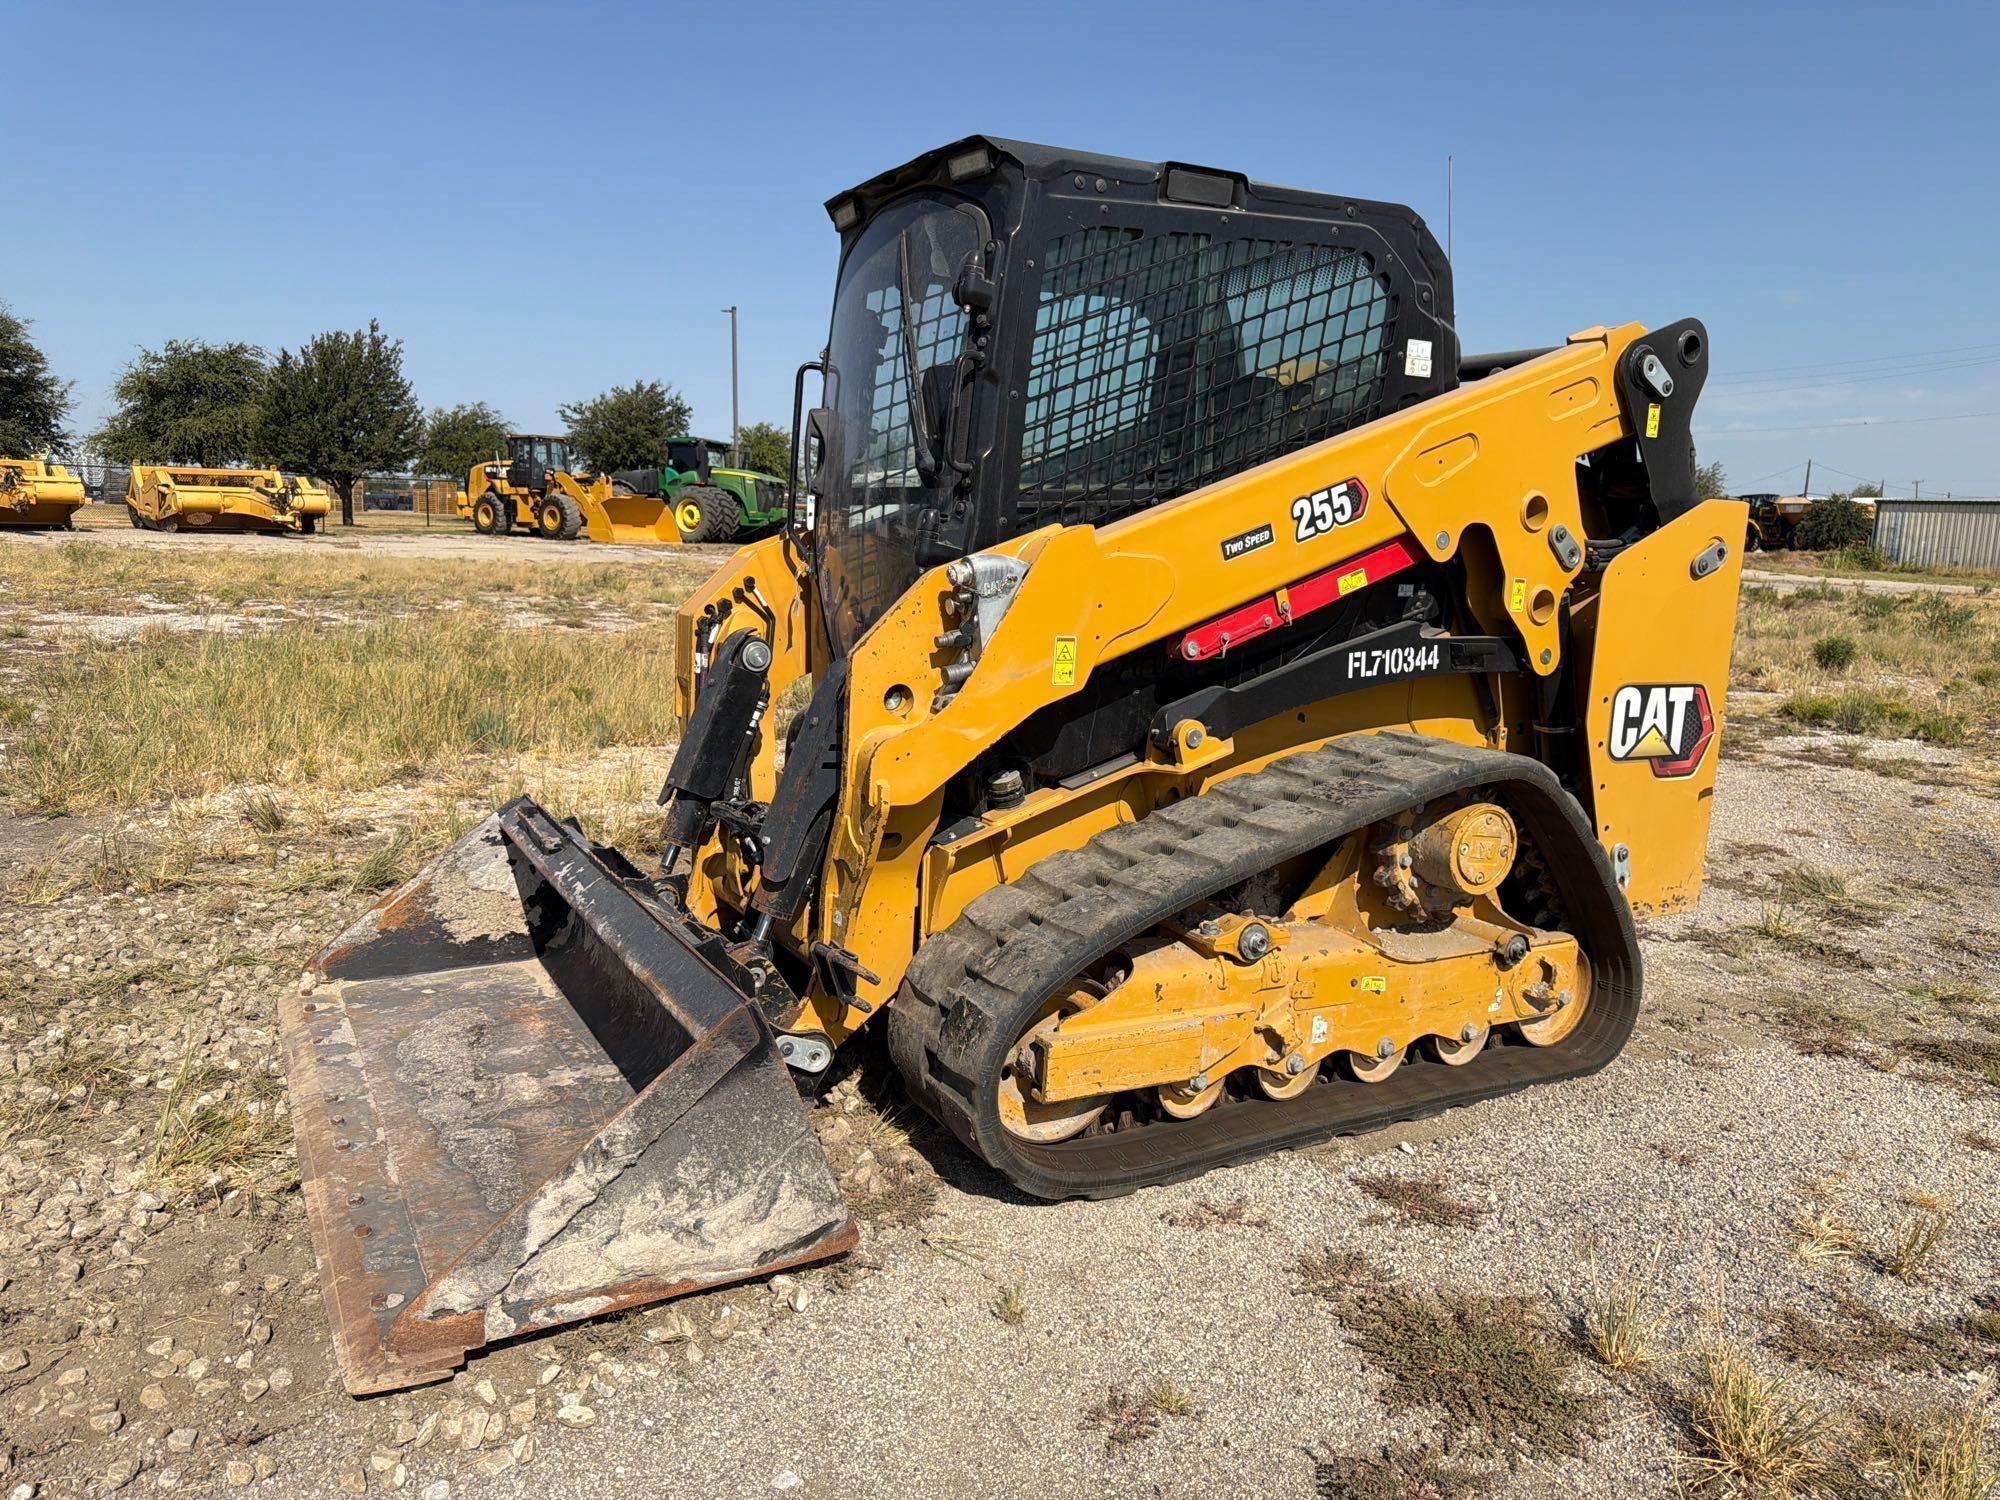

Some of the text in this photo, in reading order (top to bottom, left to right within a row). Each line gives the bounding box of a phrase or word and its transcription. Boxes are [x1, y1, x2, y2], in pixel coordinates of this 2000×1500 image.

[1292, 482, 1352, 540] 255
[1347, 644, 1440, 679] FL710344
[1610, 686, 1694, 759] CAT
